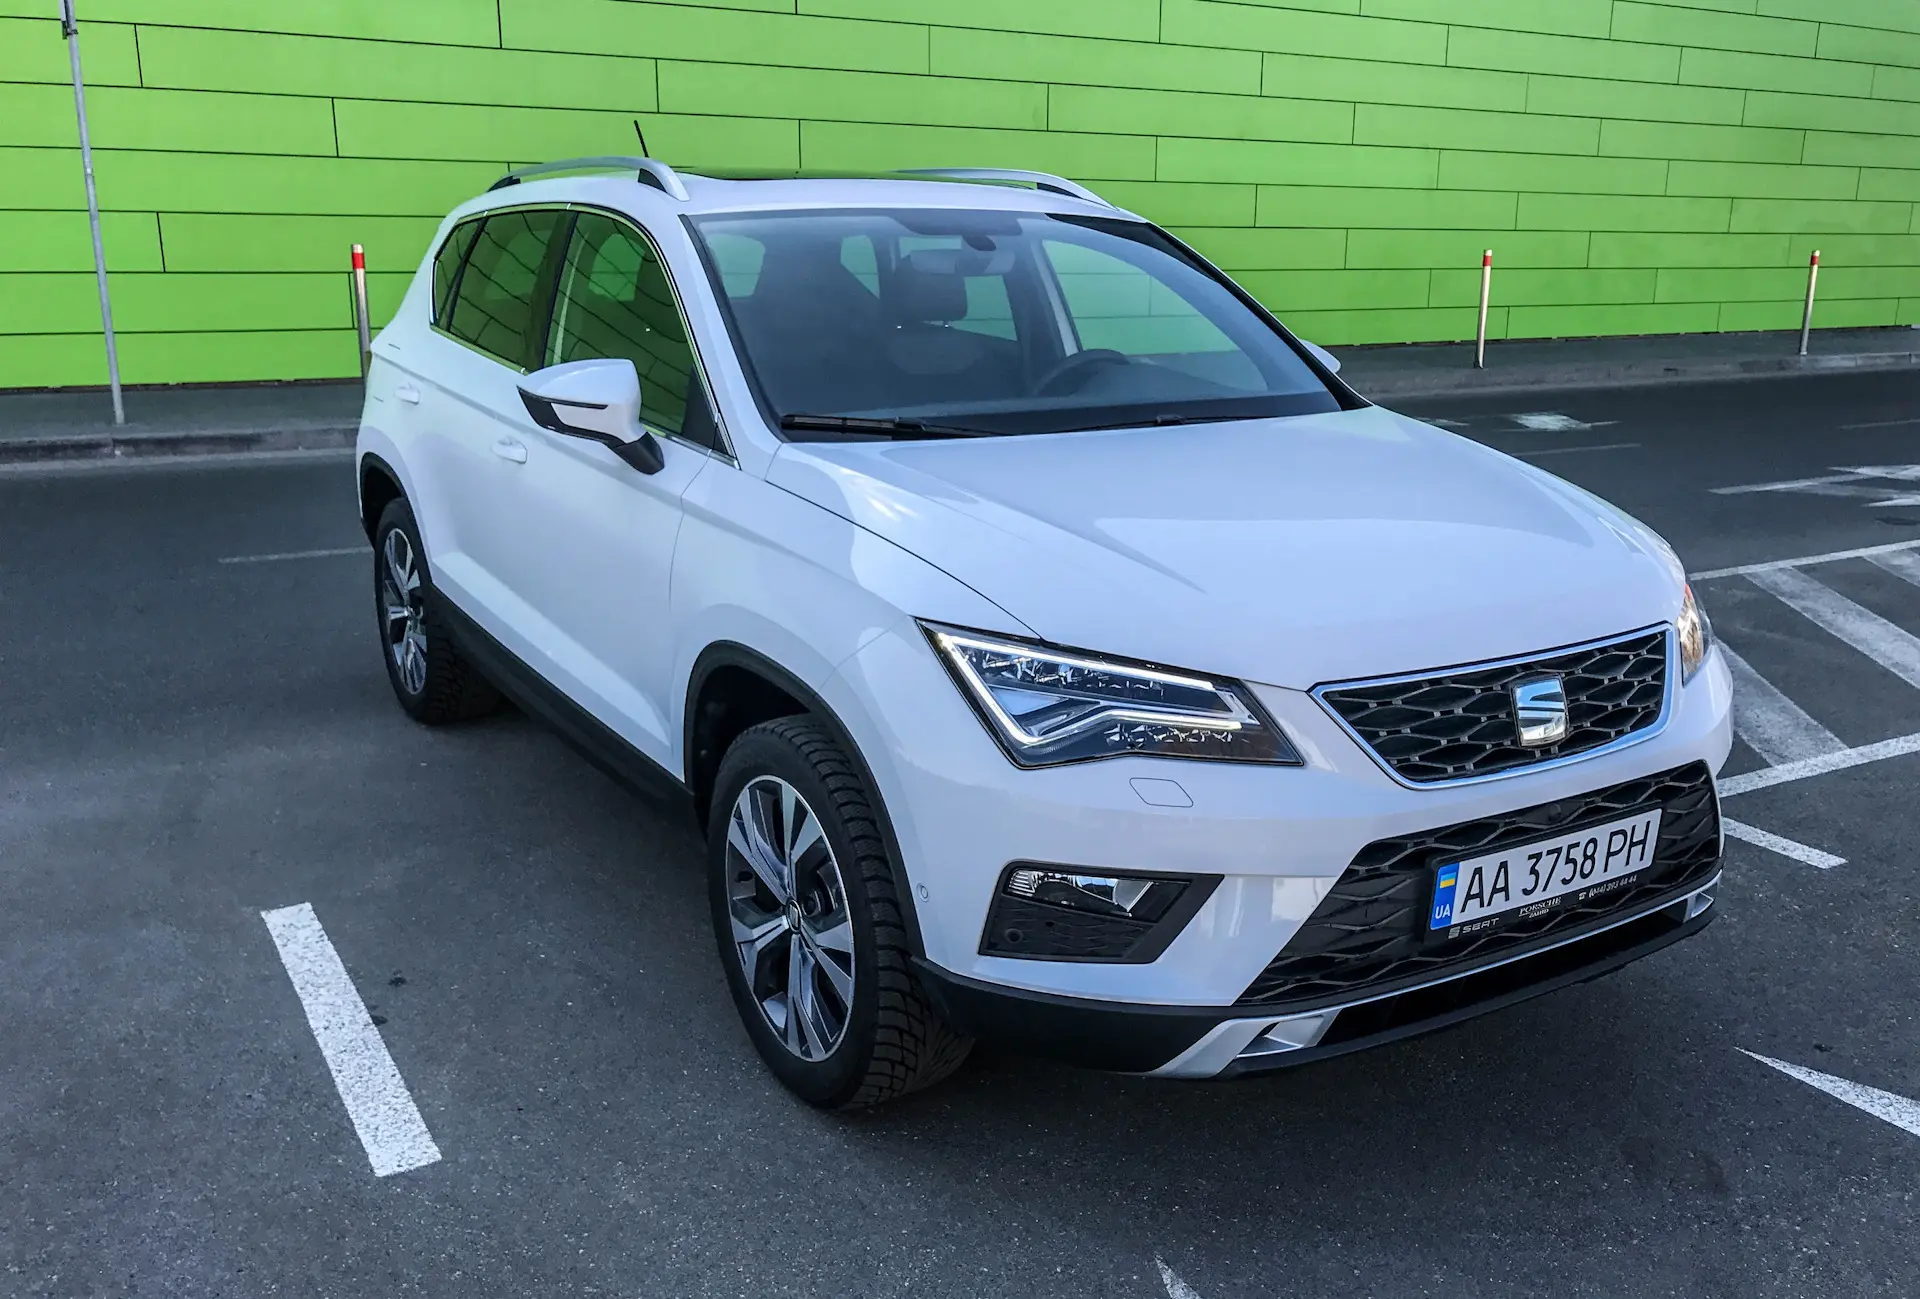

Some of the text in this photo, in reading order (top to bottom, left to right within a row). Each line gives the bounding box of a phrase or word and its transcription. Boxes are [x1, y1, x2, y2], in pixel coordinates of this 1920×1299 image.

[1460, 820, 1651, 914] AA 3758 PH
[1435, 903, 1451, 920] UA
[1462, 917, 1500, 934] SEAT
